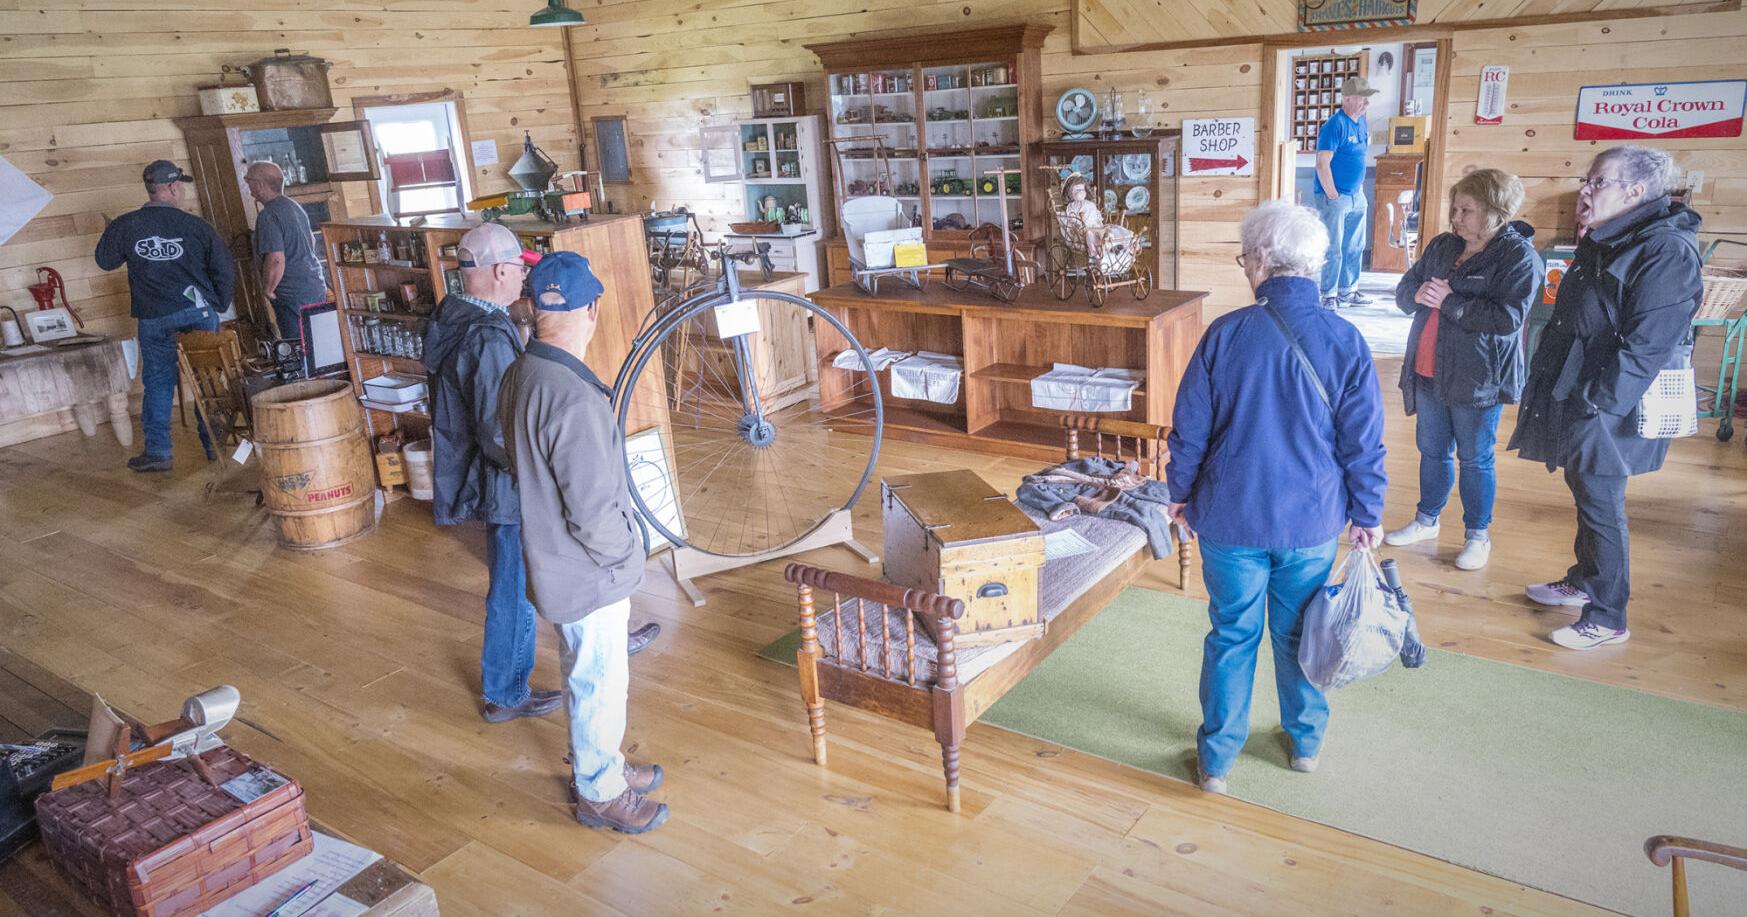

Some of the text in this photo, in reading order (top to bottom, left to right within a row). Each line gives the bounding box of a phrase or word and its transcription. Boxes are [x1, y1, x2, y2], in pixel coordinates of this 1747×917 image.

[1484, 71, 1506, 82] RC
[1602, 88, 1633, 97] DRINK
[1592, 99, 1726, 117] Royal Crown
[1192, 122, 1241, 137] BARBER
[1632, 116, 1679, 130] Cola
[1200, 138, 1238, 152] SHOP
[307, 485, 352, 502] PEANUTS
